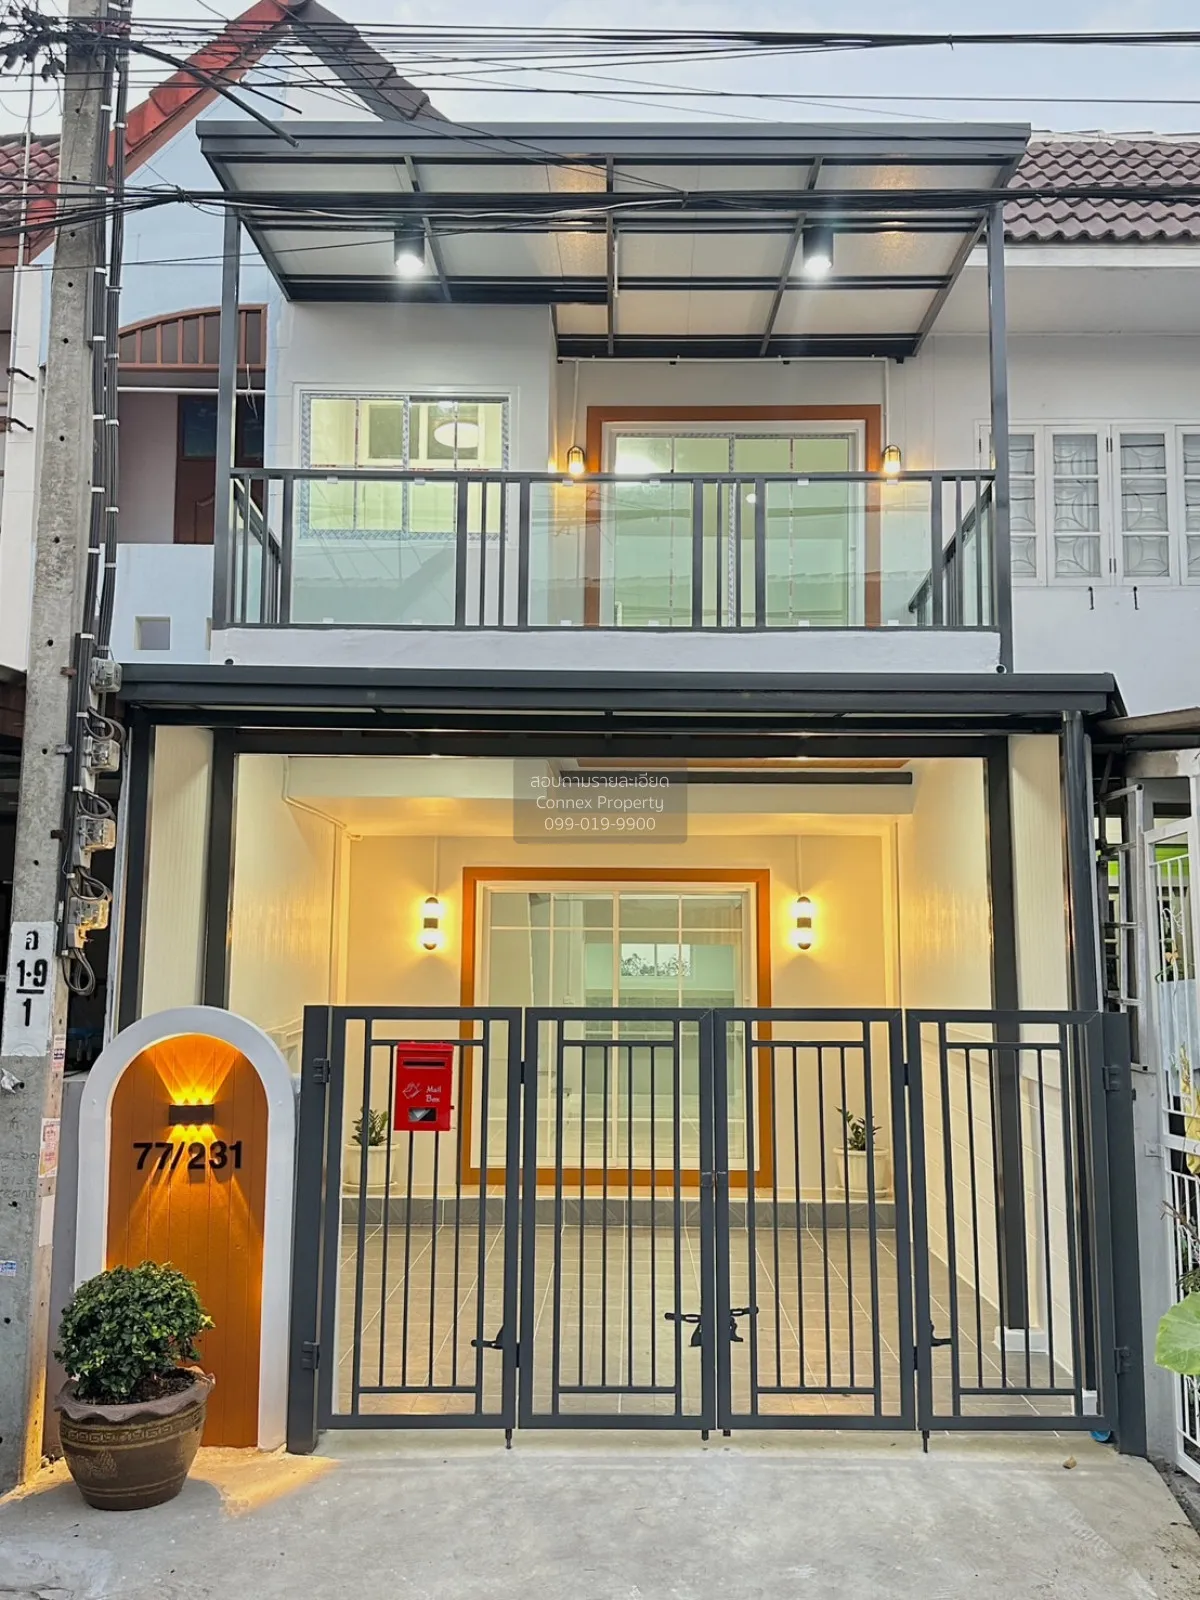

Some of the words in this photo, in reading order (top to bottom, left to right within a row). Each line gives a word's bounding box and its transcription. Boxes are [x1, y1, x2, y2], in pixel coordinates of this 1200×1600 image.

[22, 998, 32, 1027] 1
[425, 1085, 442, 1093] Mail
[133, 1140, 242, 1170] 77/231
